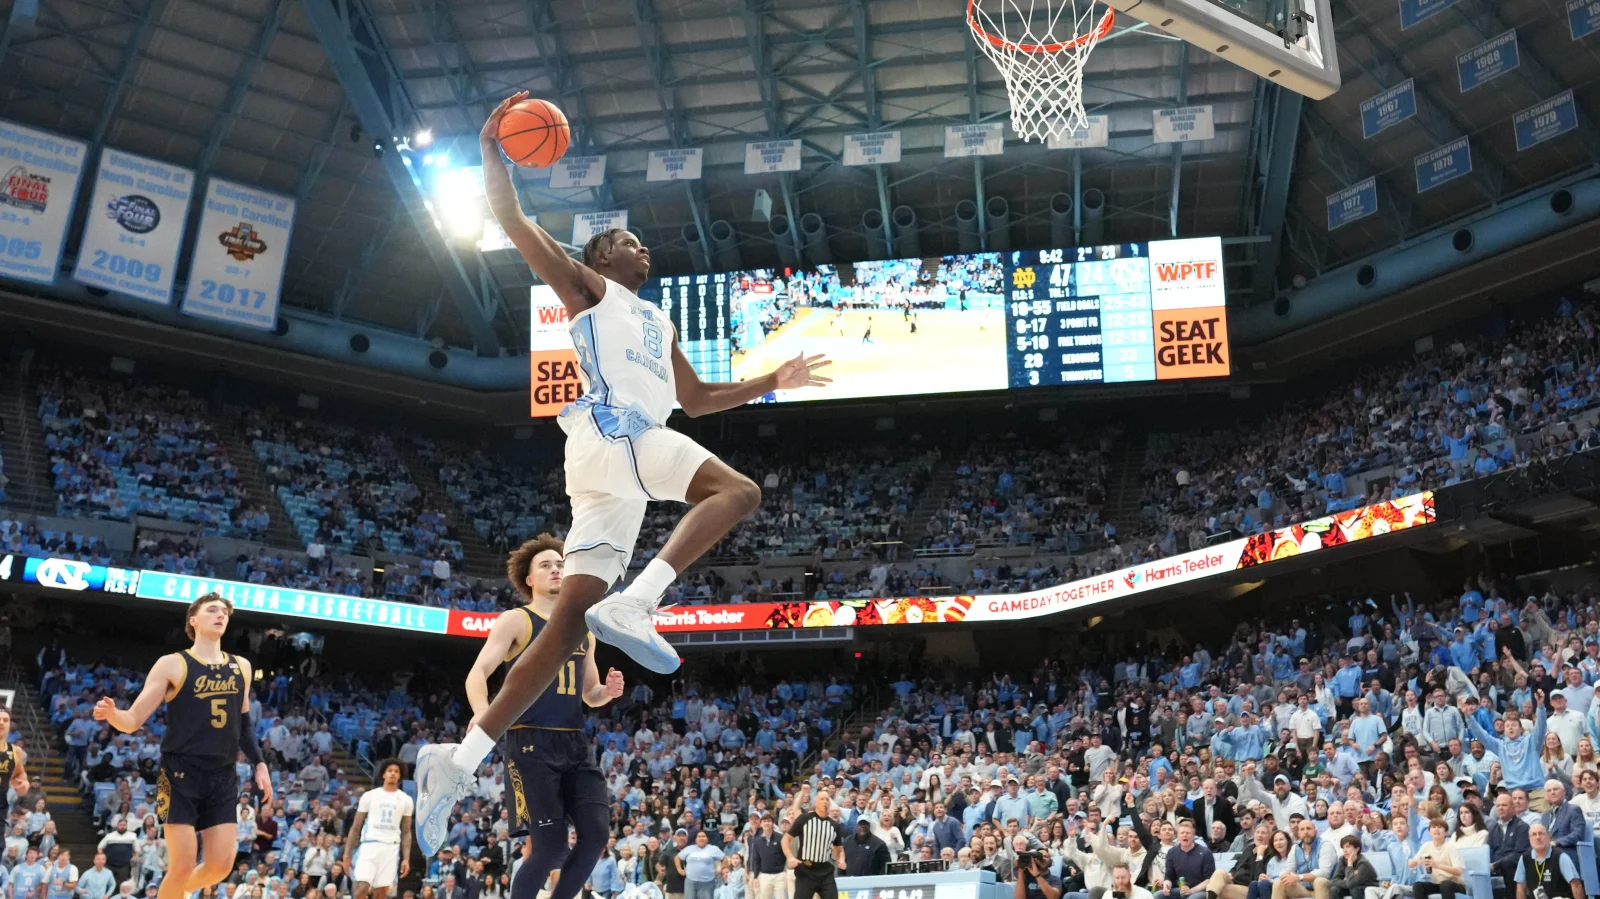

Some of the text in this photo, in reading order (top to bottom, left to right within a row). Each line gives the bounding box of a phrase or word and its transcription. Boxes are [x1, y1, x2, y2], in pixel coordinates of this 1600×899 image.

[1473, 32, 1514, 57] CHAMPIONS
[1475, 50, 1500, 70] 1968
[1376, 82, 1411, 104] CHAMPIONS
[1378, 98, 1398, 116] 1967
[1530, 93, 1570, 117] CHAMPIONS
[1534, 110, 1556, 128] 1979
[1430, 140, 1466, 160] CHAMPIONS
[110, 155, 186, 184] University of
[1432, 154, 1454, 172] 1978
[9, 176, 48, 193] FINAL
[11, 186, 48, 202] FOUR
[101, 168, 188, 200] North Carolina
[216, 184, 288, 212] University of
[1343, 195, 1360, 210] 1977
[118, 205, 156, 228] FOUR
[128, 202, 156, 218] FINAL
[208, 199, 290, 230] North Carolina
[92, 249, 162, 283] 2009
[1040, 248, 1062, 264] 9:42
[660, 274, 726, 286] PTS REB AST FLS
[1049, 264, 1072, 287] 47
[1082, 262, 1104, 284] 74
[1158, 262, 1216, 282] WPTF
[199, 279, 267, 310] 2017
[680, 286, 688, 296] 2
[698, 284, 706, 296] 0
[716, 283, 724, 294] 0
[700, 296, 704, 306] 1
[1056, 298, 1100, 312] FIELD GOALS
[698, 306, 706, 318] 3
[718, 306, 722, 316] 1
[699, 318, 706, 329] 0
[717, 316, 724, 328] 0
[1060, 318, 1066, 329] 3
[1066, 317, 1088, 328] POINT
[1160, 318, 1220, 342] SEAT
[642, 322, 662, 359] 8
[700, 329, 705, 340] 1
[717, 328, 724, 338] 3
[1016, 334, 1049, 352] 5-10
[1058, 334, 1102, 348] FREE THROWS
[1158, 342, 1225, 366] GEEK
[538, 360, 578, 382] SEA
[1029, 370, 1040, 386] 3
[1060, 369, 1102, 382] TURNOVERS
[104, 579, 127, 594] FLS:
[130, 570, 140, 583] 3
[988, 554, 1224, 612] GAMEDAY TOGETHER Harris Teeter
[164, 577, 426, 628] CAROLINA BASKETBALL
[696, 610, 744, 624] Teeter
[193, 675, 239, 695] Irish
[556, 660, 576, 696] 11
[210, 698, 227, 728] 5
